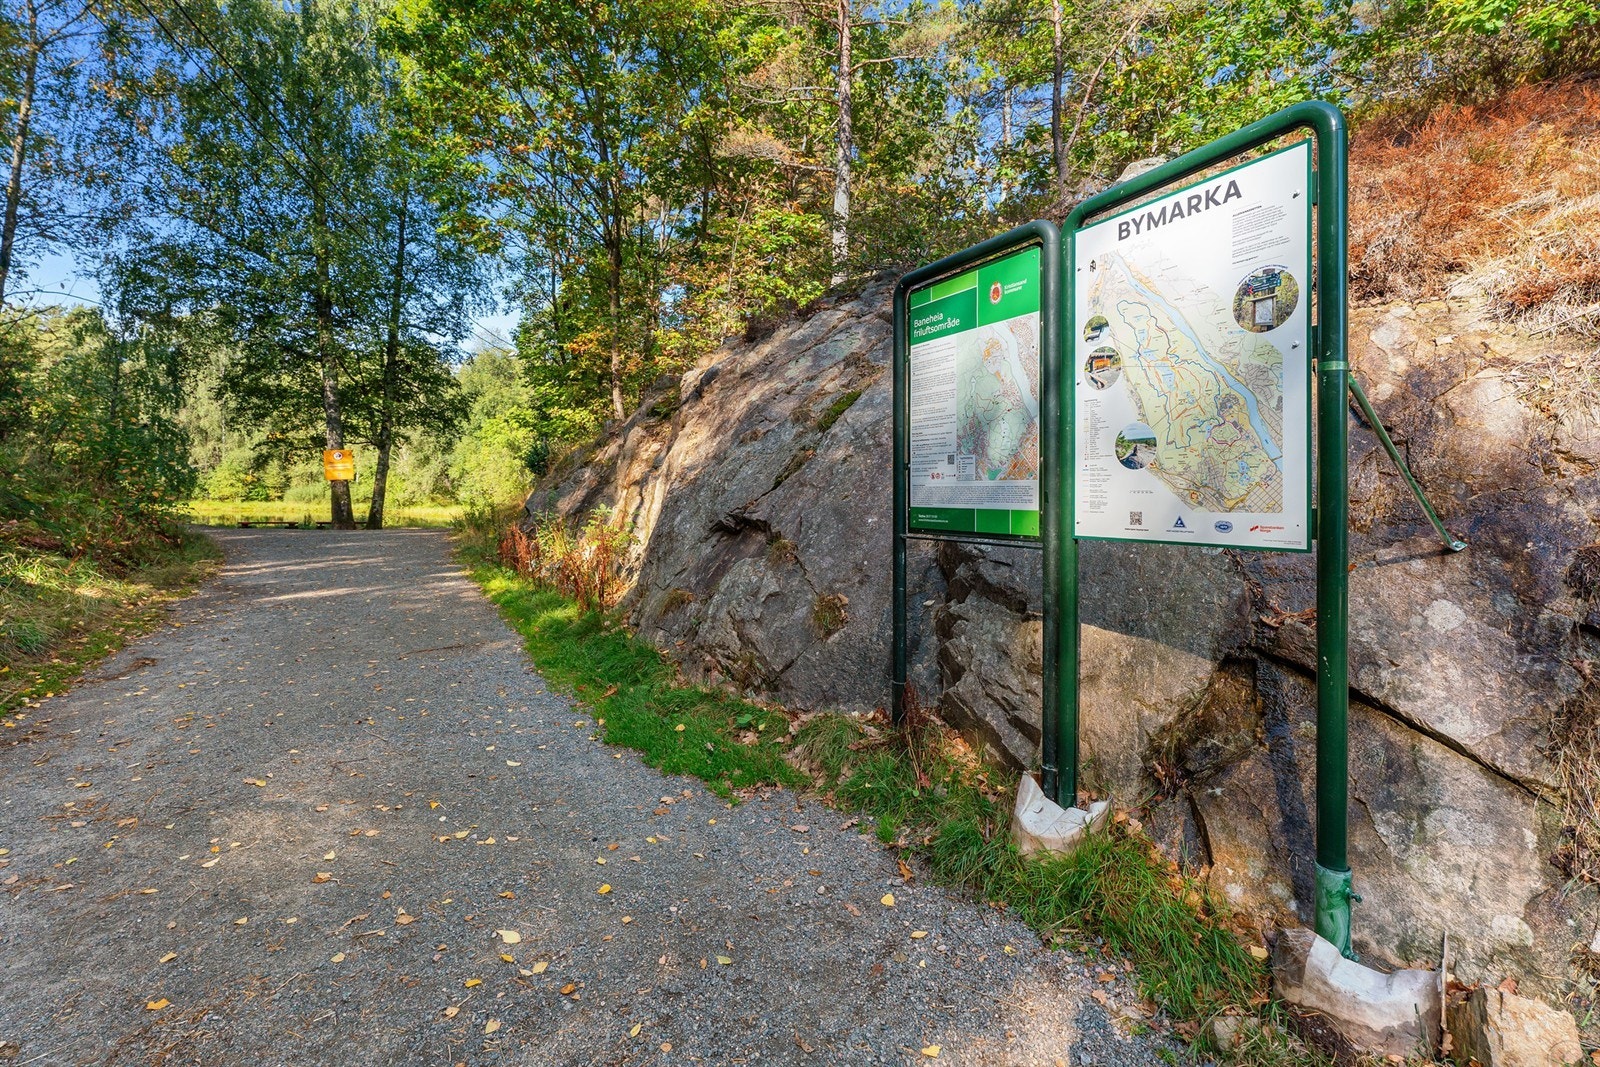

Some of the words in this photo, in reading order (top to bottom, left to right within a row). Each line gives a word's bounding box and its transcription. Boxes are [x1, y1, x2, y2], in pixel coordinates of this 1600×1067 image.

[1118, 179, 1242, 241] BYMARKA
[914, 312, 944, 328] Baneheia
[914, 317, 960, 338] friluftsområde
